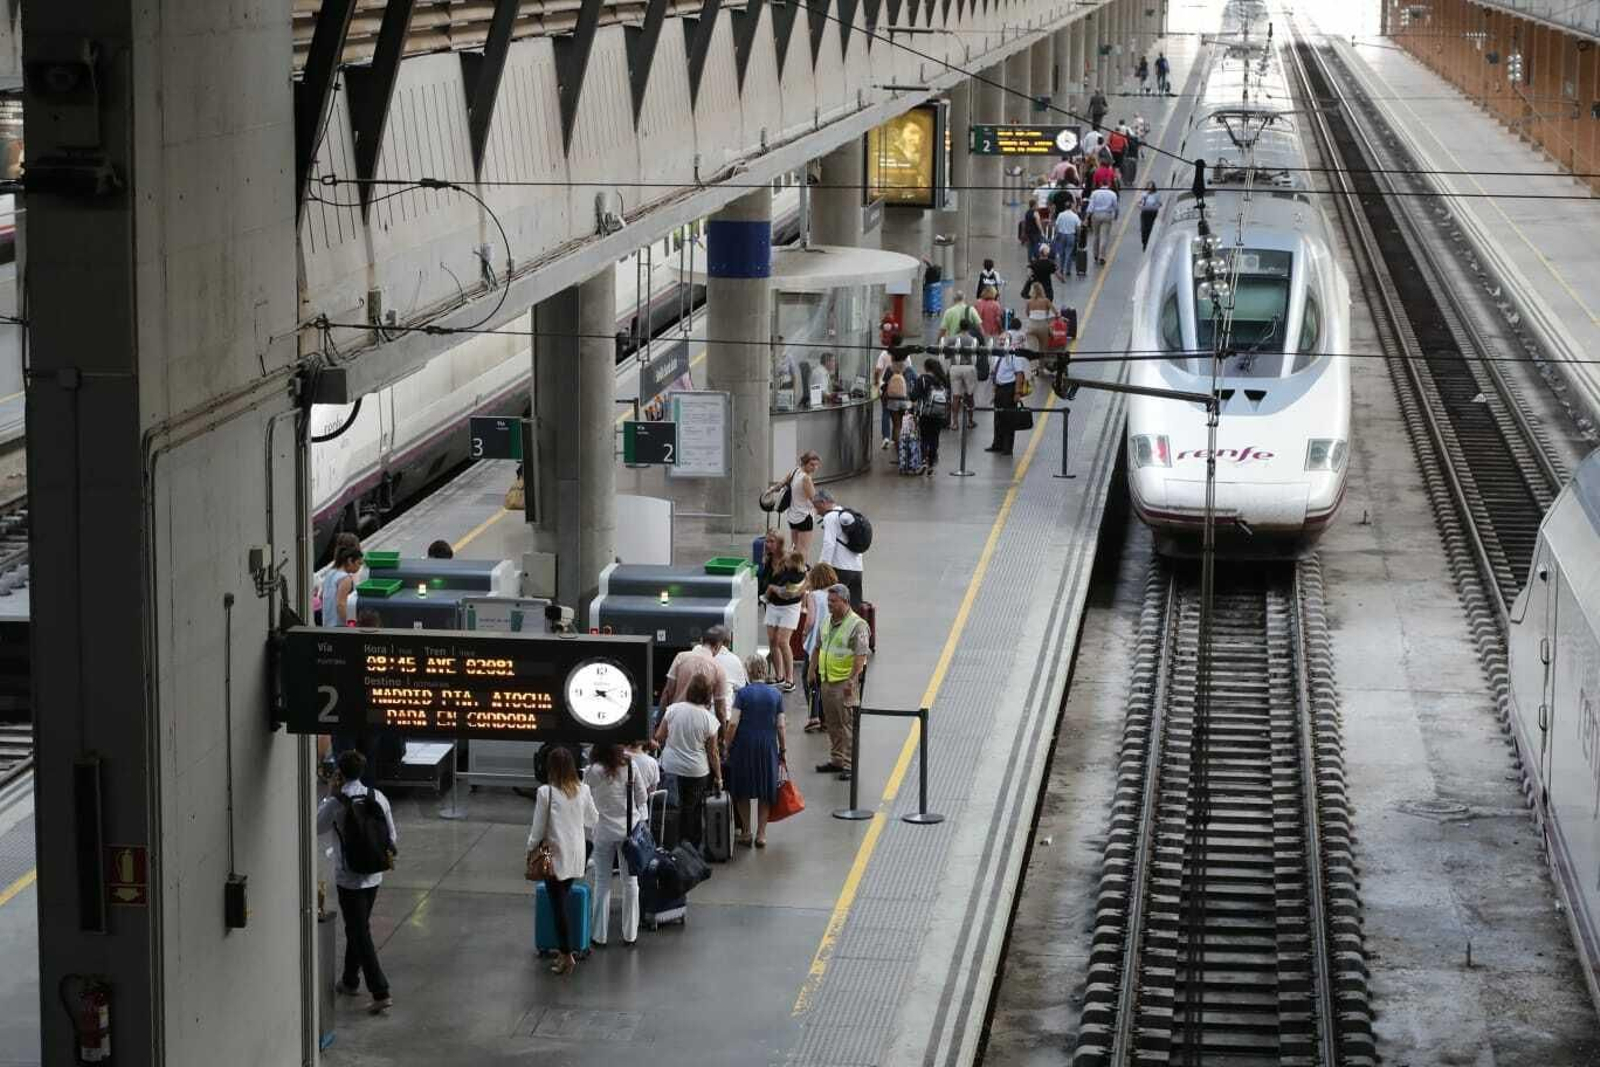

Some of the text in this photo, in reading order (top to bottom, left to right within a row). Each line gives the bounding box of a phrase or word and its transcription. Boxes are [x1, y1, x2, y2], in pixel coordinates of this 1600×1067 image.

[982, 140, 991, 152] 2
[472, 438, 483, 457] 3
[663, 443, 674, 463] 2
[1177, 446, 1274, 462] renfe
[364, 644, 387, 655] Hora
[366, 655, 417, 672] 08:45
[426, 657, 457, 674] AVE
[466, 659, 515, 676] 02081
[364, 676, 402, 688] Destino
[317, 685, 339, 723] 2
[372, 688, 433, 706] MADRID
[491, 691, 552, 709] ATOCHA
[386, 709, 537, 730] PARA EN CORDOBA
